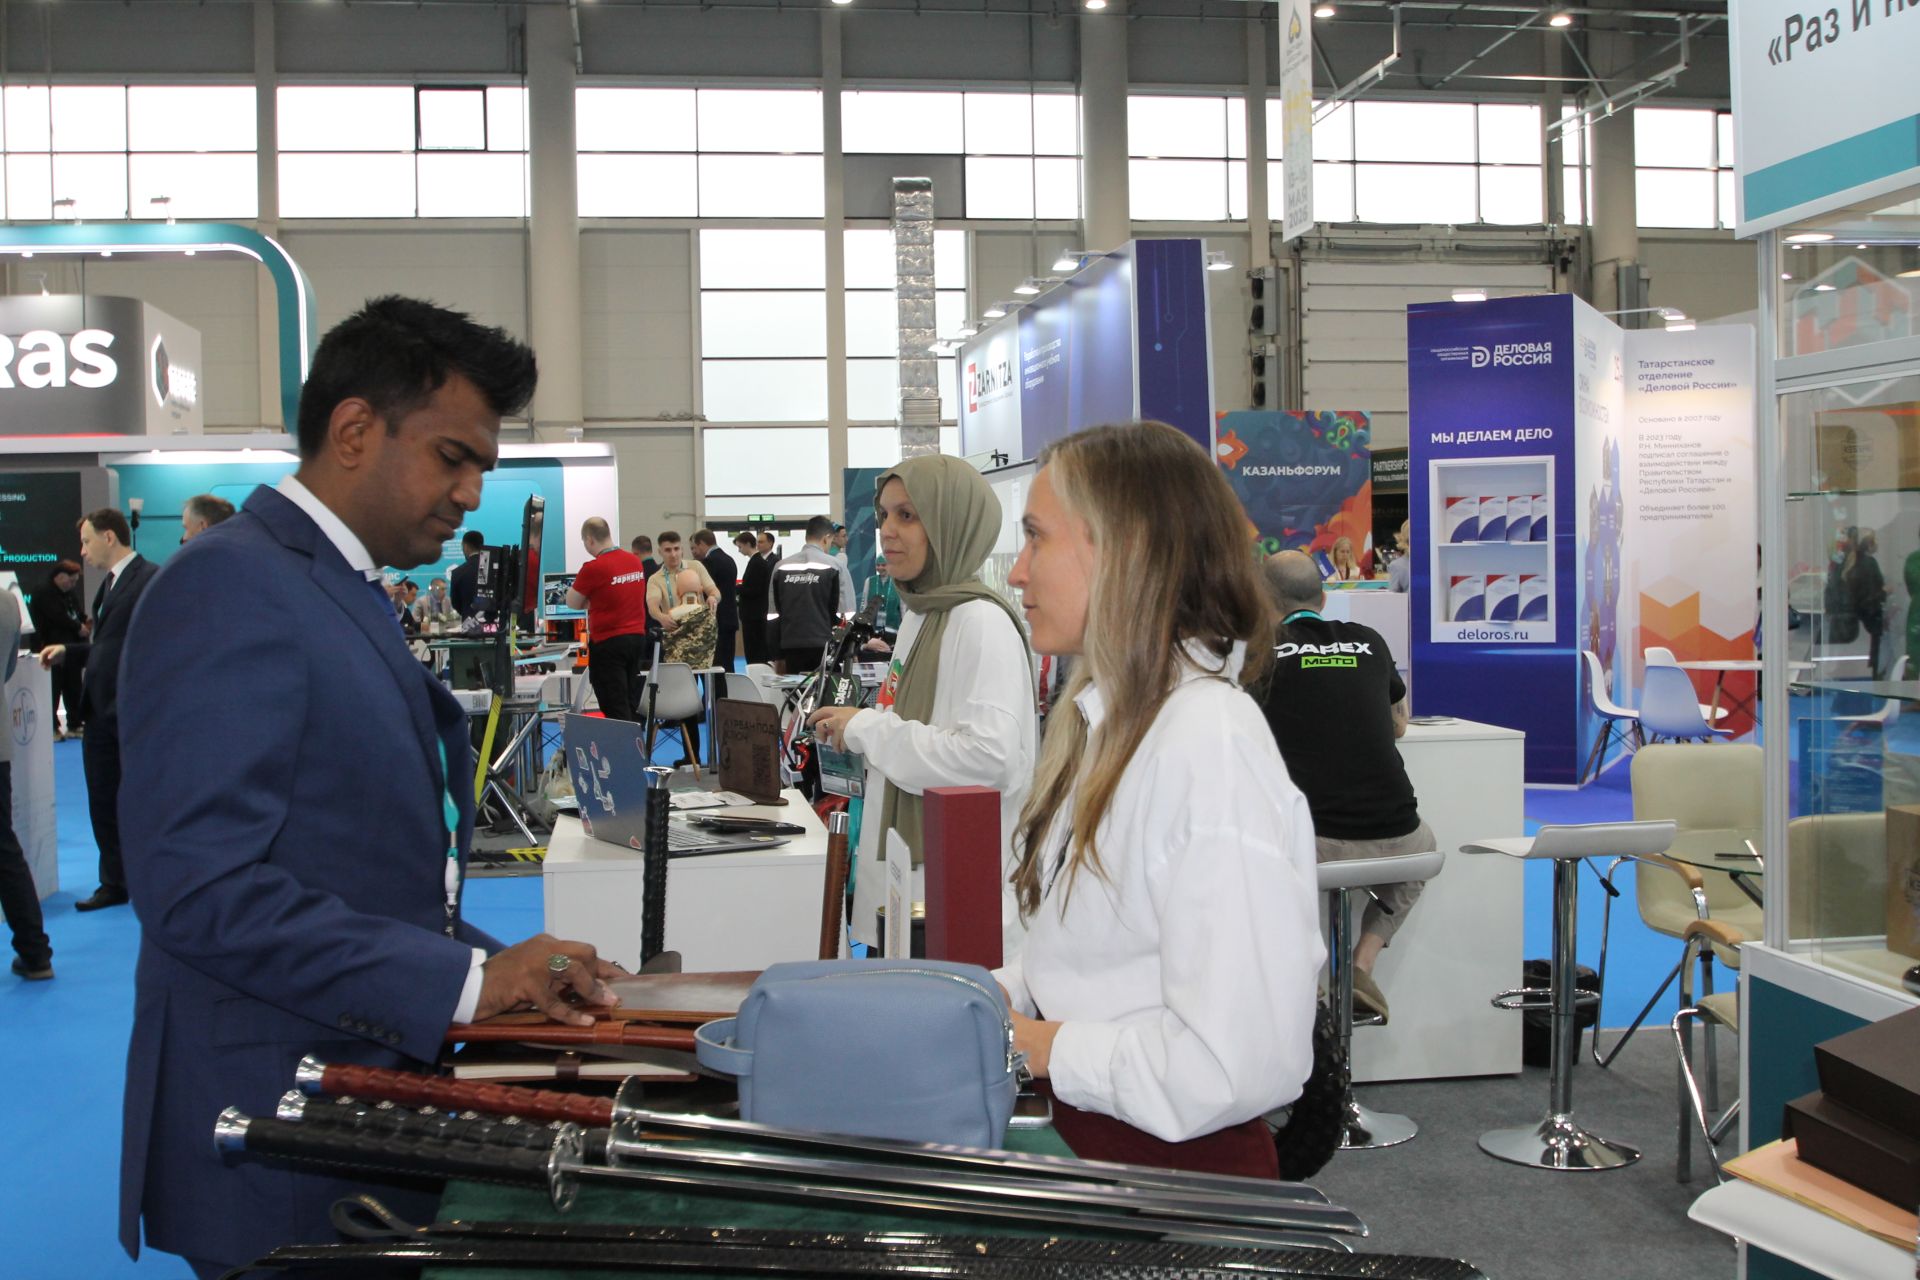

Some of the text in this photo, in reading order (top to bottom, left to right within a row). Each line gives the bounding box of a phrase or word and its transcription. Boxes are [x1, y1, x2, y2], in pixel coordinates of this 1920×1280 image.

[1768, 8, 1840, 66] «Раз
[1493, 342, 1552, 355] ДЕЛОВАЯ
[1493, 353, 1552, 367] РОССИЯ
[1638, 359, 1715, 369] Татарстанское
[1638, 371, 1693, 381] отделение
[1638, 383, 1690, 393] «Деловой
[1431, 428, 1553, 444] МЫ ДЕЛАЕМ ДЕЛО
[1242, 465, 1341, 477] КАЗАНЬФОРУМ
[4, 554, 57, 563] PRODUCTION
[1457, 628, 1529, 640] deloros.ru
[1304, 657, 1354, 667] MOTO
